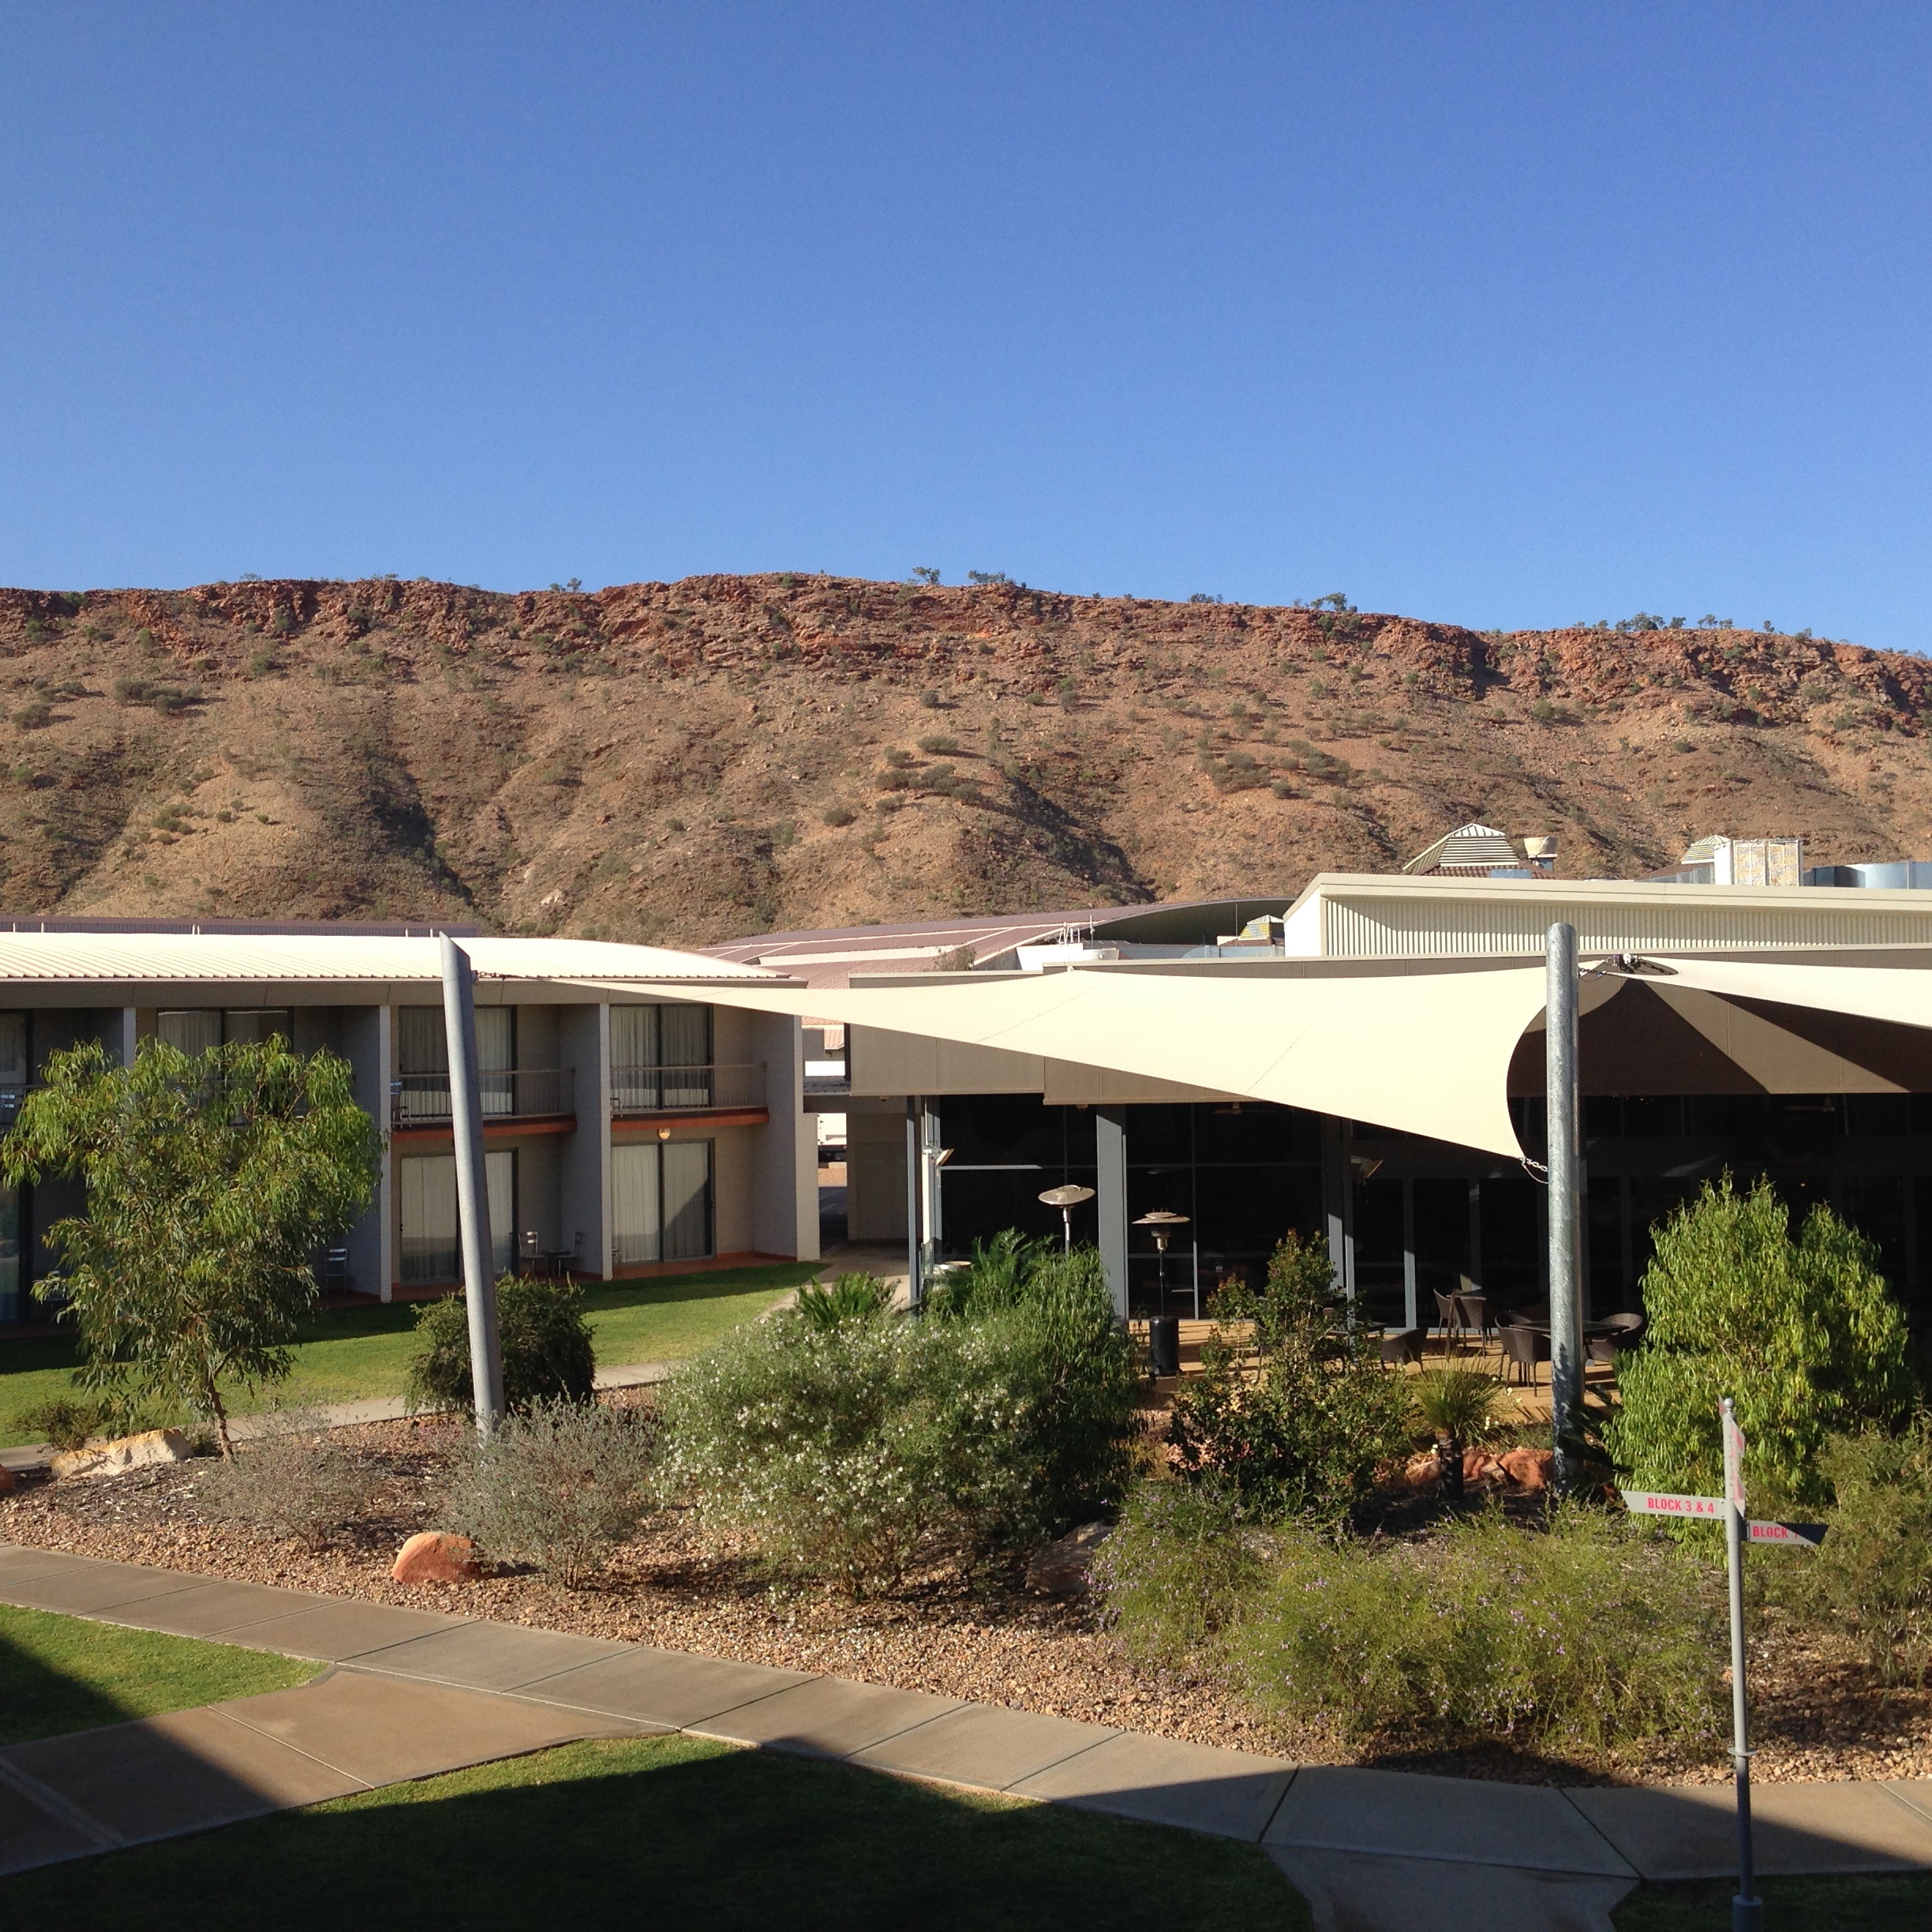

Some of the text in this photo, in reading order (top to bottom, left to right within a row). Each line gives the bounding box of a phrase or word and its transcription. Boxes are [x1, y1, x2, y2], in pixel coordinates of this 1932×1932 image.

[1647, 1497, 1714, 1514] BLOCK 3 & 4
[1752, 1526, 1788, 1539] BLOCK
